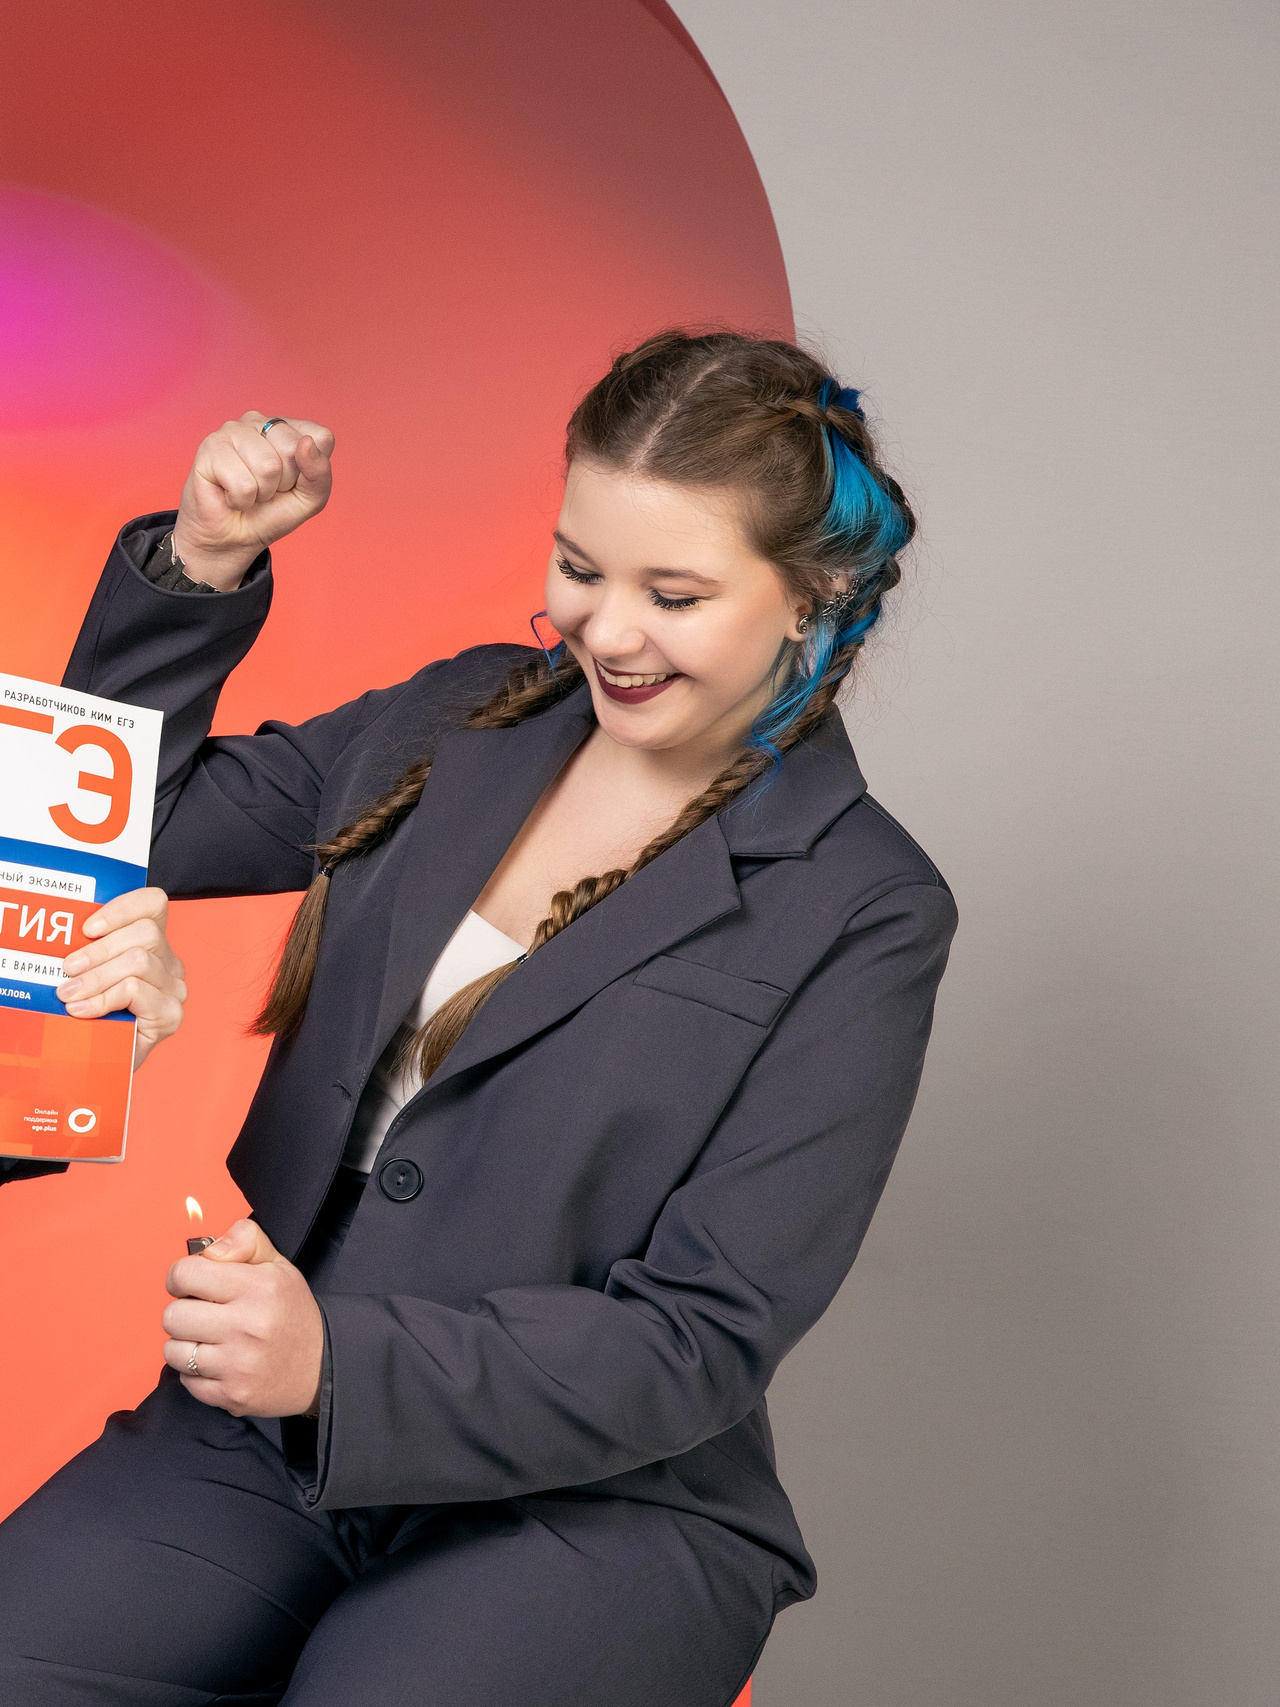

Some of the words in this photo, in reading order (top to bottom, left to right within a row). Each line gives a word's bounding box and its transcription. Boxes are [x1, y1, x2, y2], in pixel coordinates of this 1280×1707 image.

[4, 690, 86, 717] РАЗРАБОТЧИКОВ
[91, 710, 112, 723] КИМ
[117, 717, 135, 729] ЕГЭ
[28, 876, 82, 893] ЭКЗАМЕН
